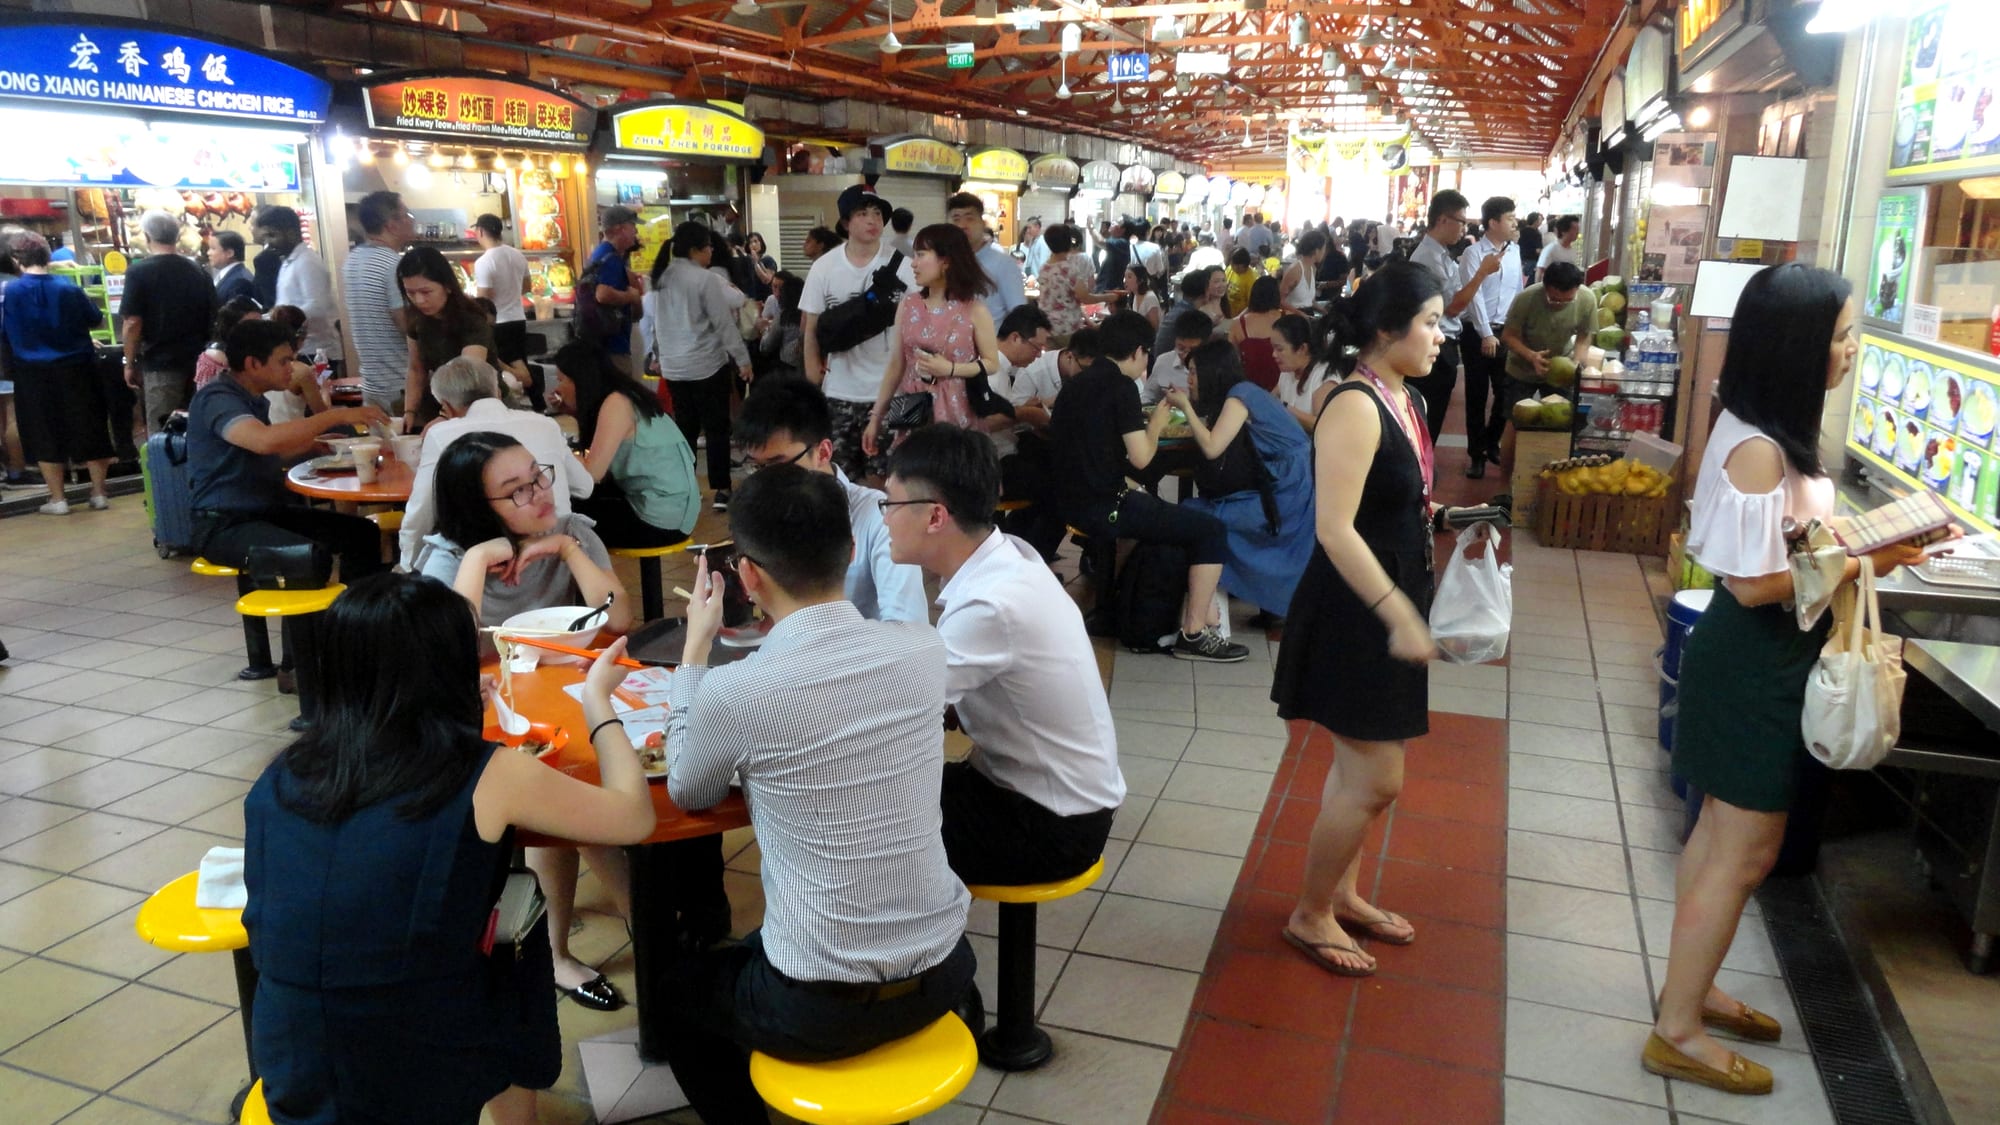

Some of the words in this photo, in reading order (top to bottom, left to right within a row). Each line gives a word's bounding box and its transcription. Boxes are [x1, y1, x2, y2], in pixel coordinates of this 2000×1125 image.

[68, 33, 234, 85] 宏香鸡饭
[953, 54, 968, 65] EXIT
[0, 70, 40, 92] ONG
[43, 74, 99, 98] XIANG
[104, 80, 196, 107] HAINANESE
[198, 89, 261, 112] CHICKEN
[263, 95, 294, 115] RICE
[396, 116, 414, 126] Fried
[415, 118, 434, 129] Kway
[634, 136, 664, 145] ZHEN
[671, 140, 698, 148] ZHEN
[704, 143, 752, 153] PORRIDGE
